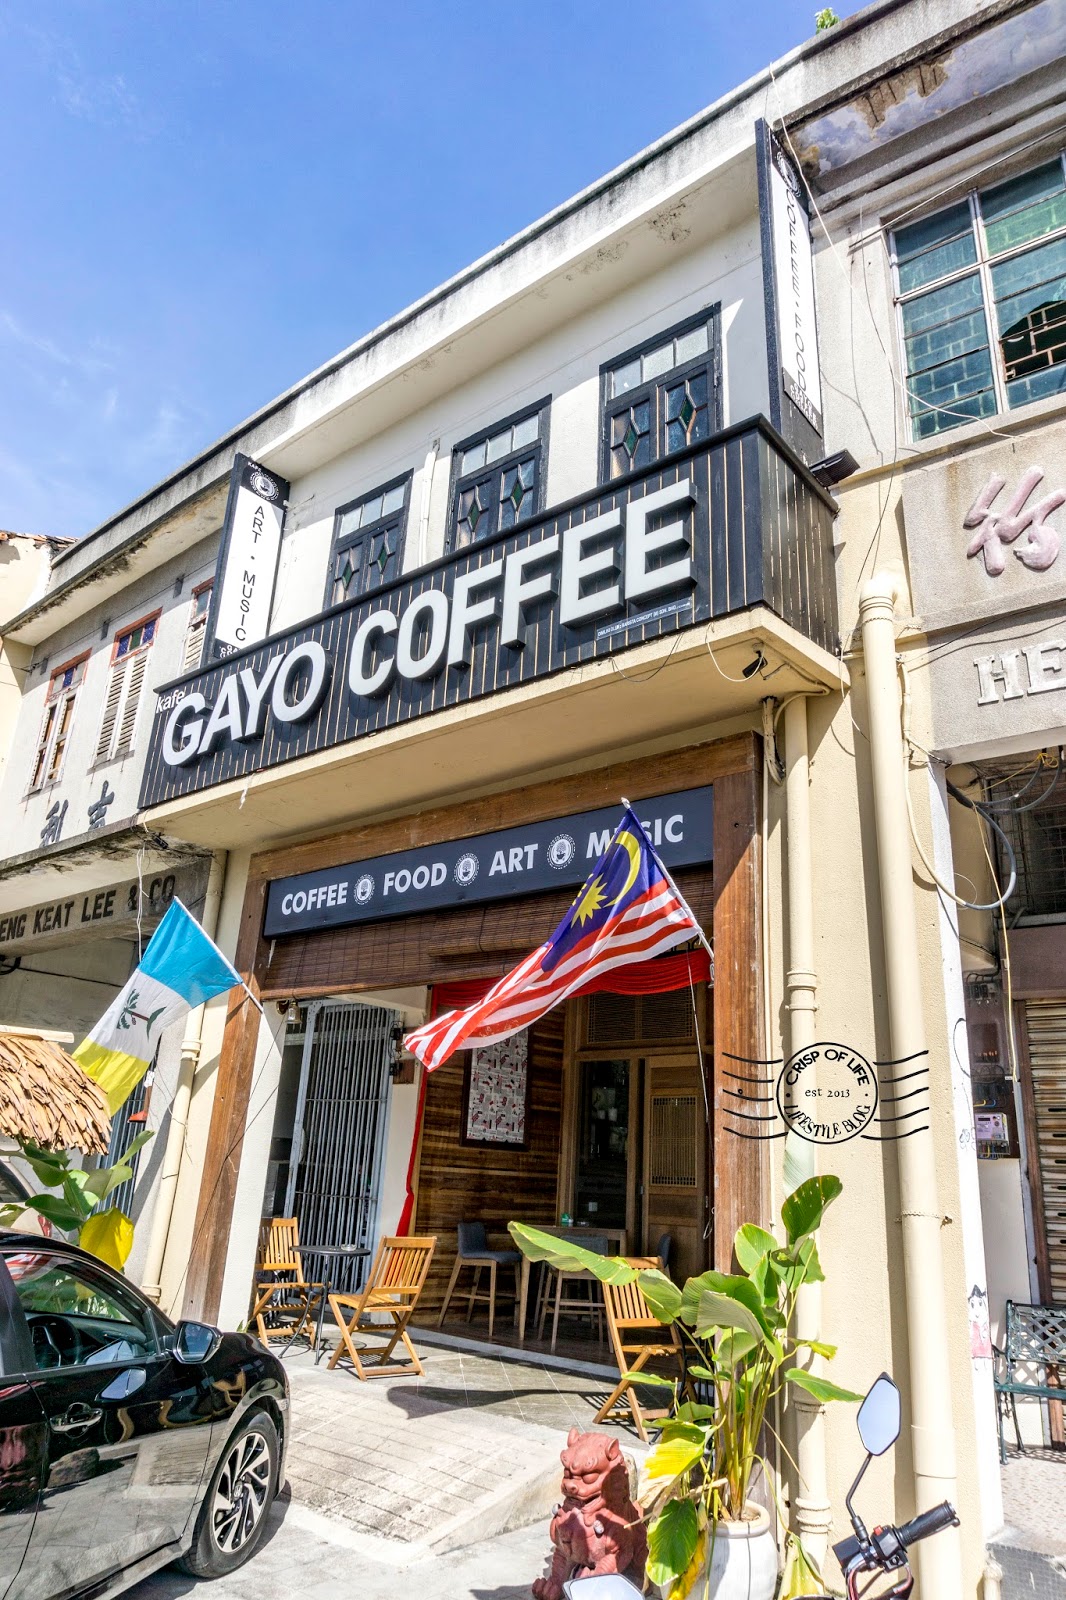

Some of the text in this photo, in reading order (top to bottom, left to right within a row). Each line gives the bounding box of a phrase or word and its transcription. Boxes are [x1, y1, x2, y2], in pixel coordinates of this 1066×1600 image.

[251, 505, 265, 544] ART
[162, 478, 692, 766] GAYO COFFEE
[235, 569, 256, 642] MUSIC
[155, 689, 186, 714] kafe
[281, 881, 348, 915] COFFEE
[383, 862, 447, 896] FOOD
[488, 843, 538, 877] ART
[585, 814, 683, 859] MSIC
[32, 901, 74, 934] KEAT
[81, 890, 116, 922] LEE
[150, 874, 176, 907] CO
